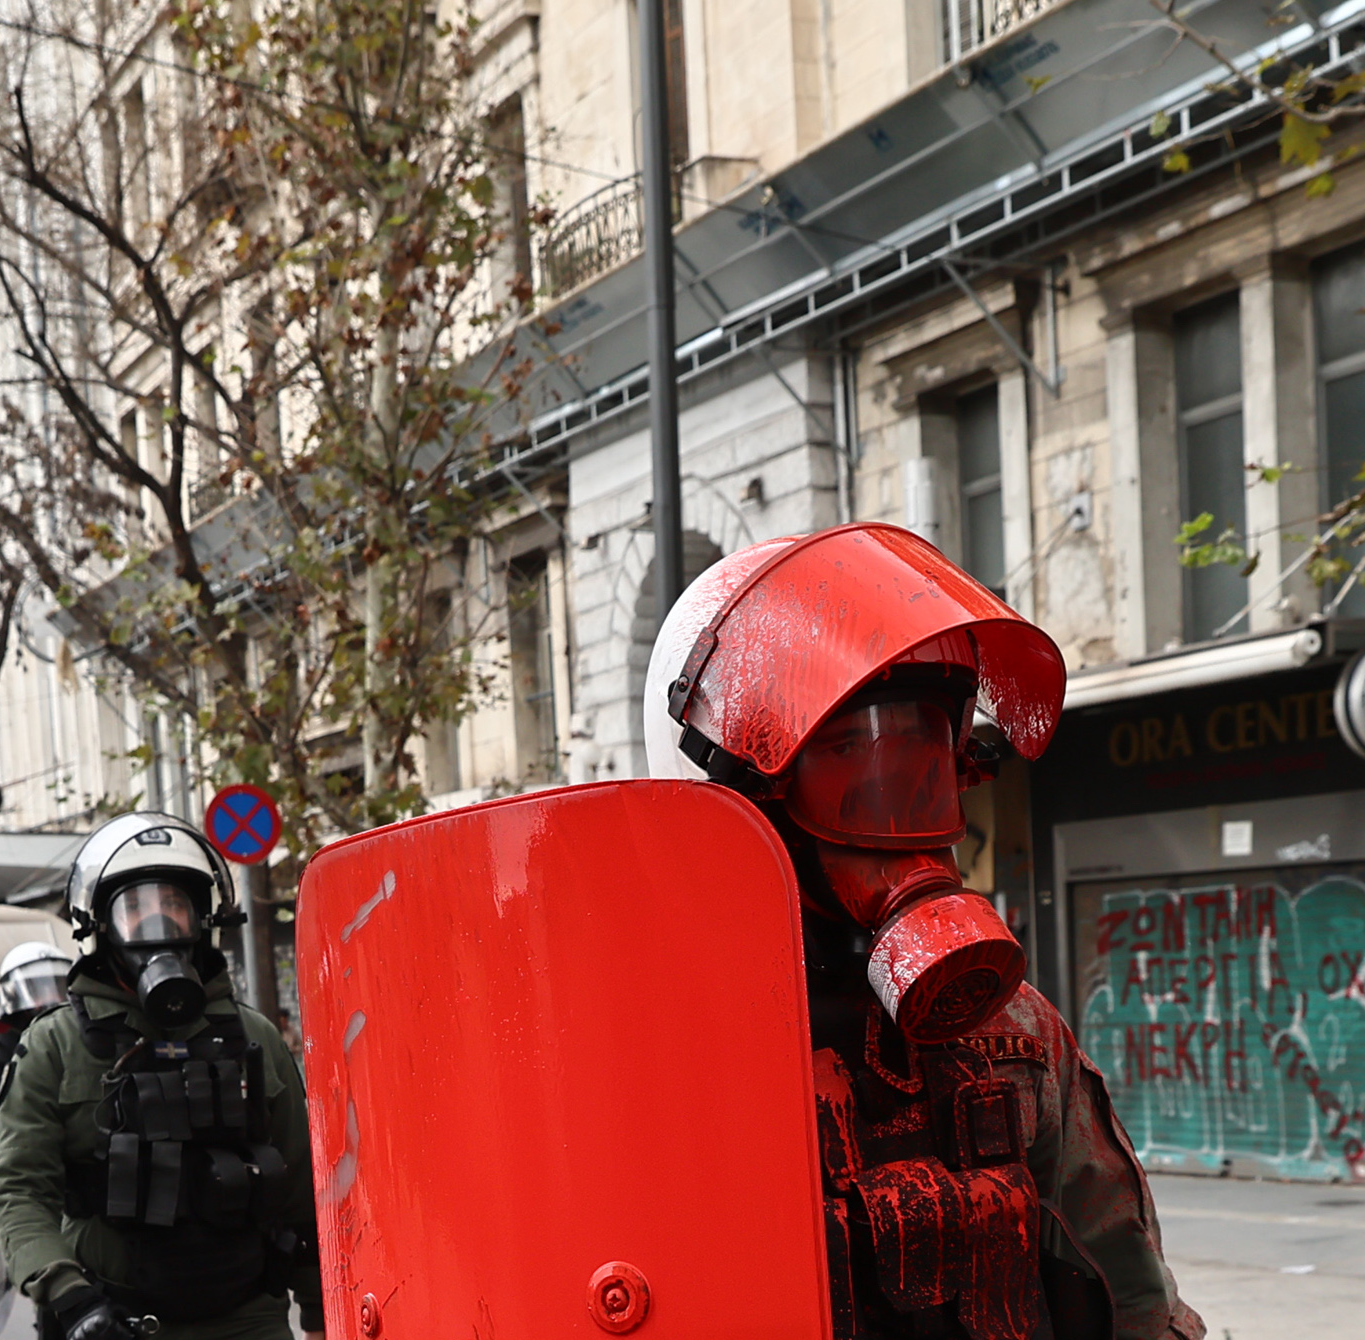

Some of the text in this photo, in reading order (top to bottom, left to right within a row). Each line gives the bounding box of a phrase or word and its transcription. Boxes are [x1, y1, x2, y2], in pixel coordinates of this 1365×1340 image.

[1109, 690, 1338, 767] ORA CENTE
[958, 1036, 1048, 1059] OLICE
